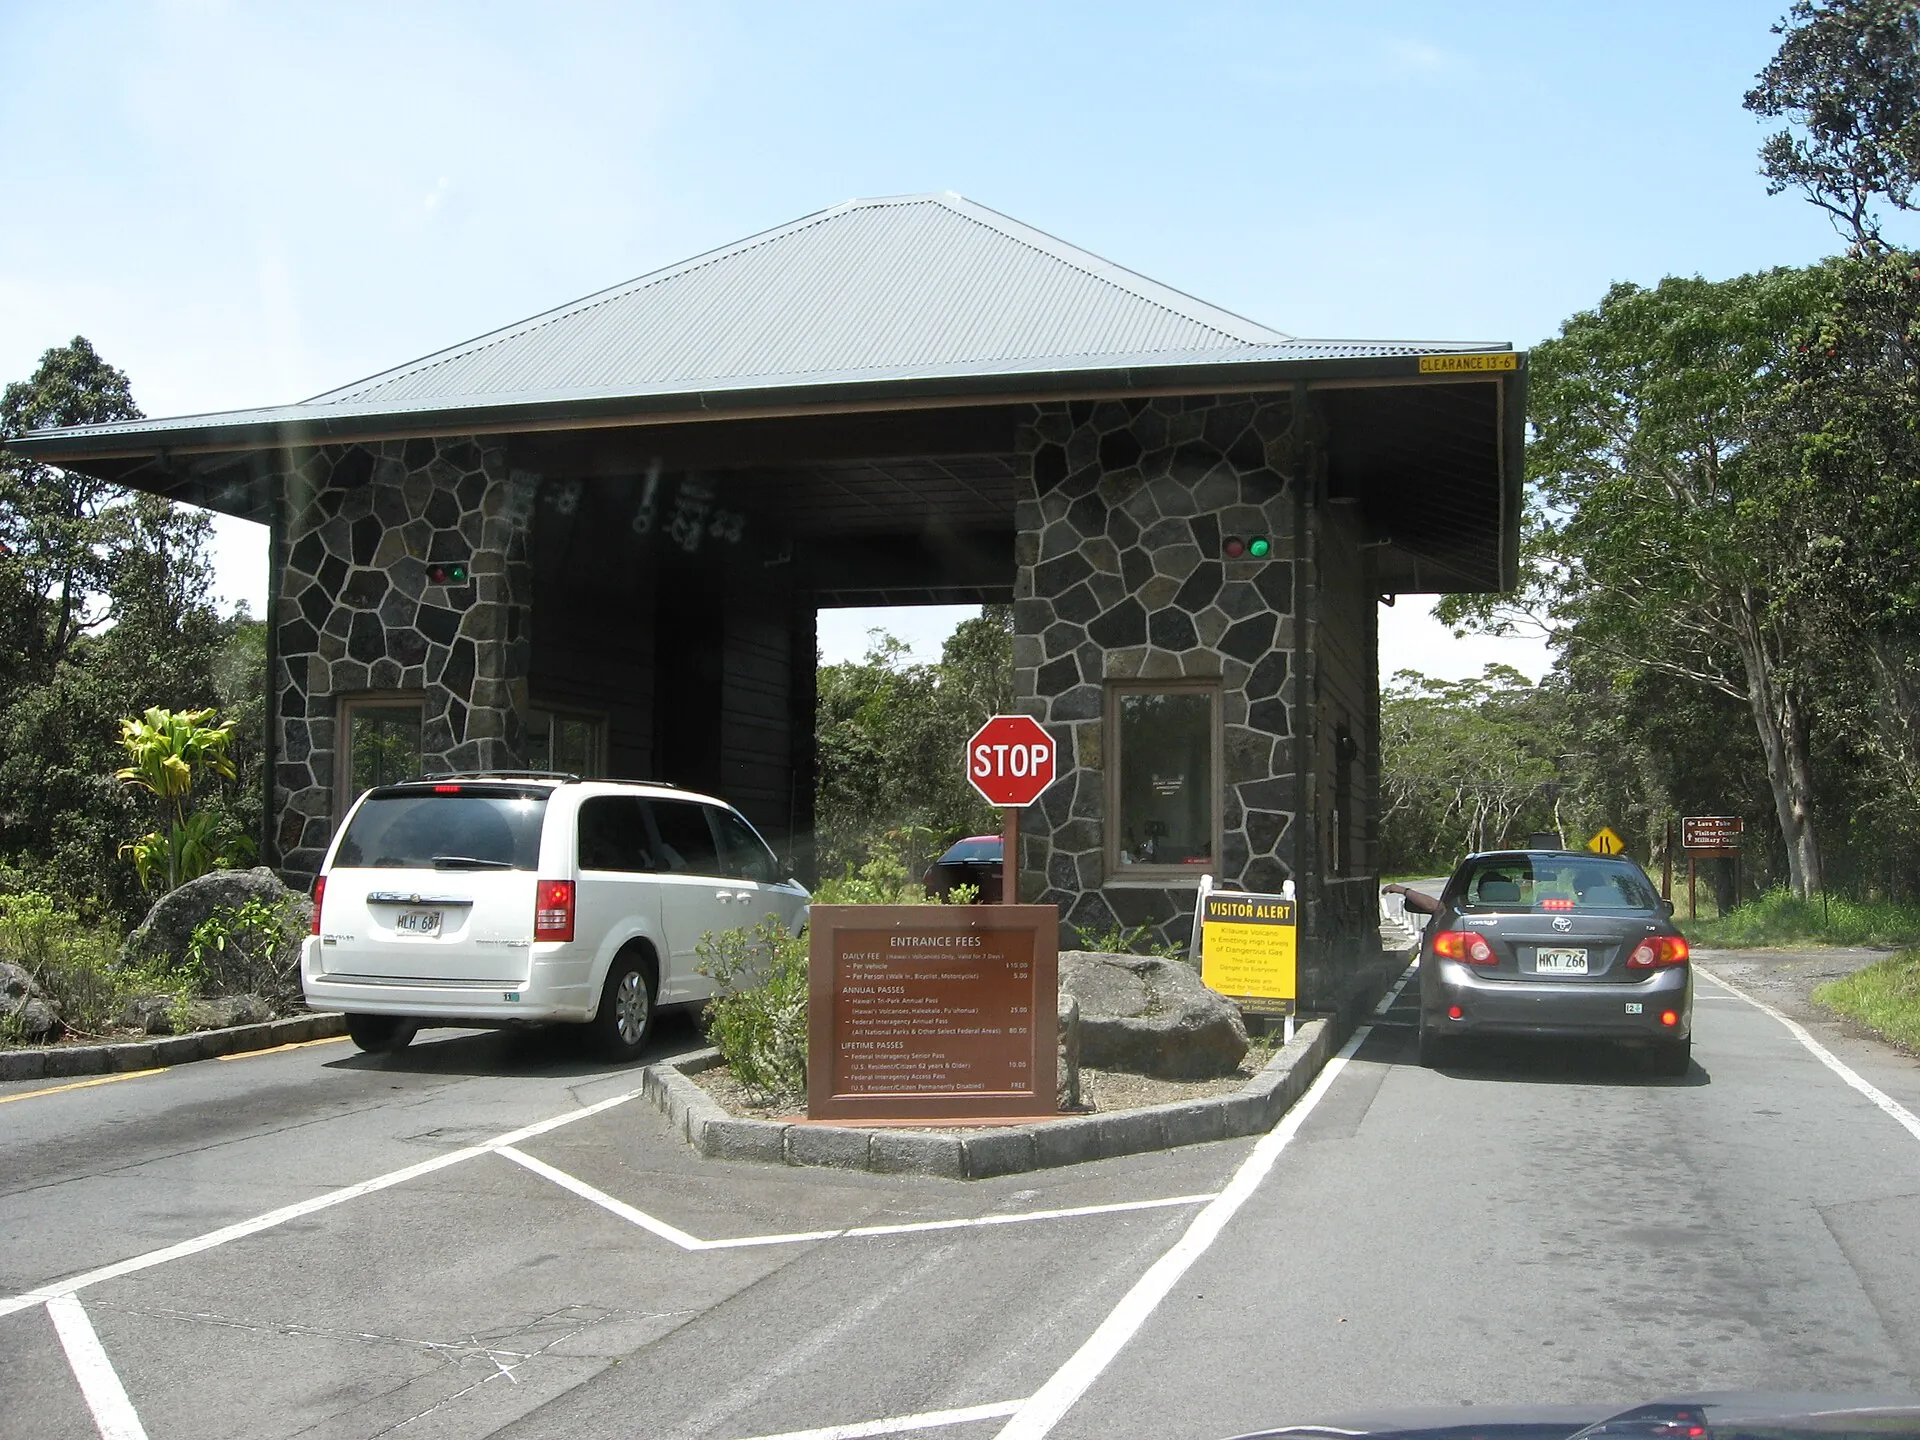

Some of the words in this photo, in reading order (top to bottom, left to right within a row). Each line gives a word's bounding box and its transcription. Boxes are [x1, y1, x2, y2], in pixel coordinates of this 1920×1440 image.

[1420, 358, 1483, 371] CLEARANCE
[974, 744, 1049, 777] STOP
[1210, 902, 1253, 917] VISITOR
[1256, 906, 1290, 919] ALERT
[398, 916, 417, 930] HLH
[422, 916, 438, 930] 687
[890, 937, 951, 947] ENTRANCE
[956, 936, 981, 947] FEES
[1218, 937, 1248, 945] Emitting
[1226, 946, 1266, 955] Dangerous
[1539, 954, 1558, 968] HKY
[1566, 954, 1585, 968] 266
